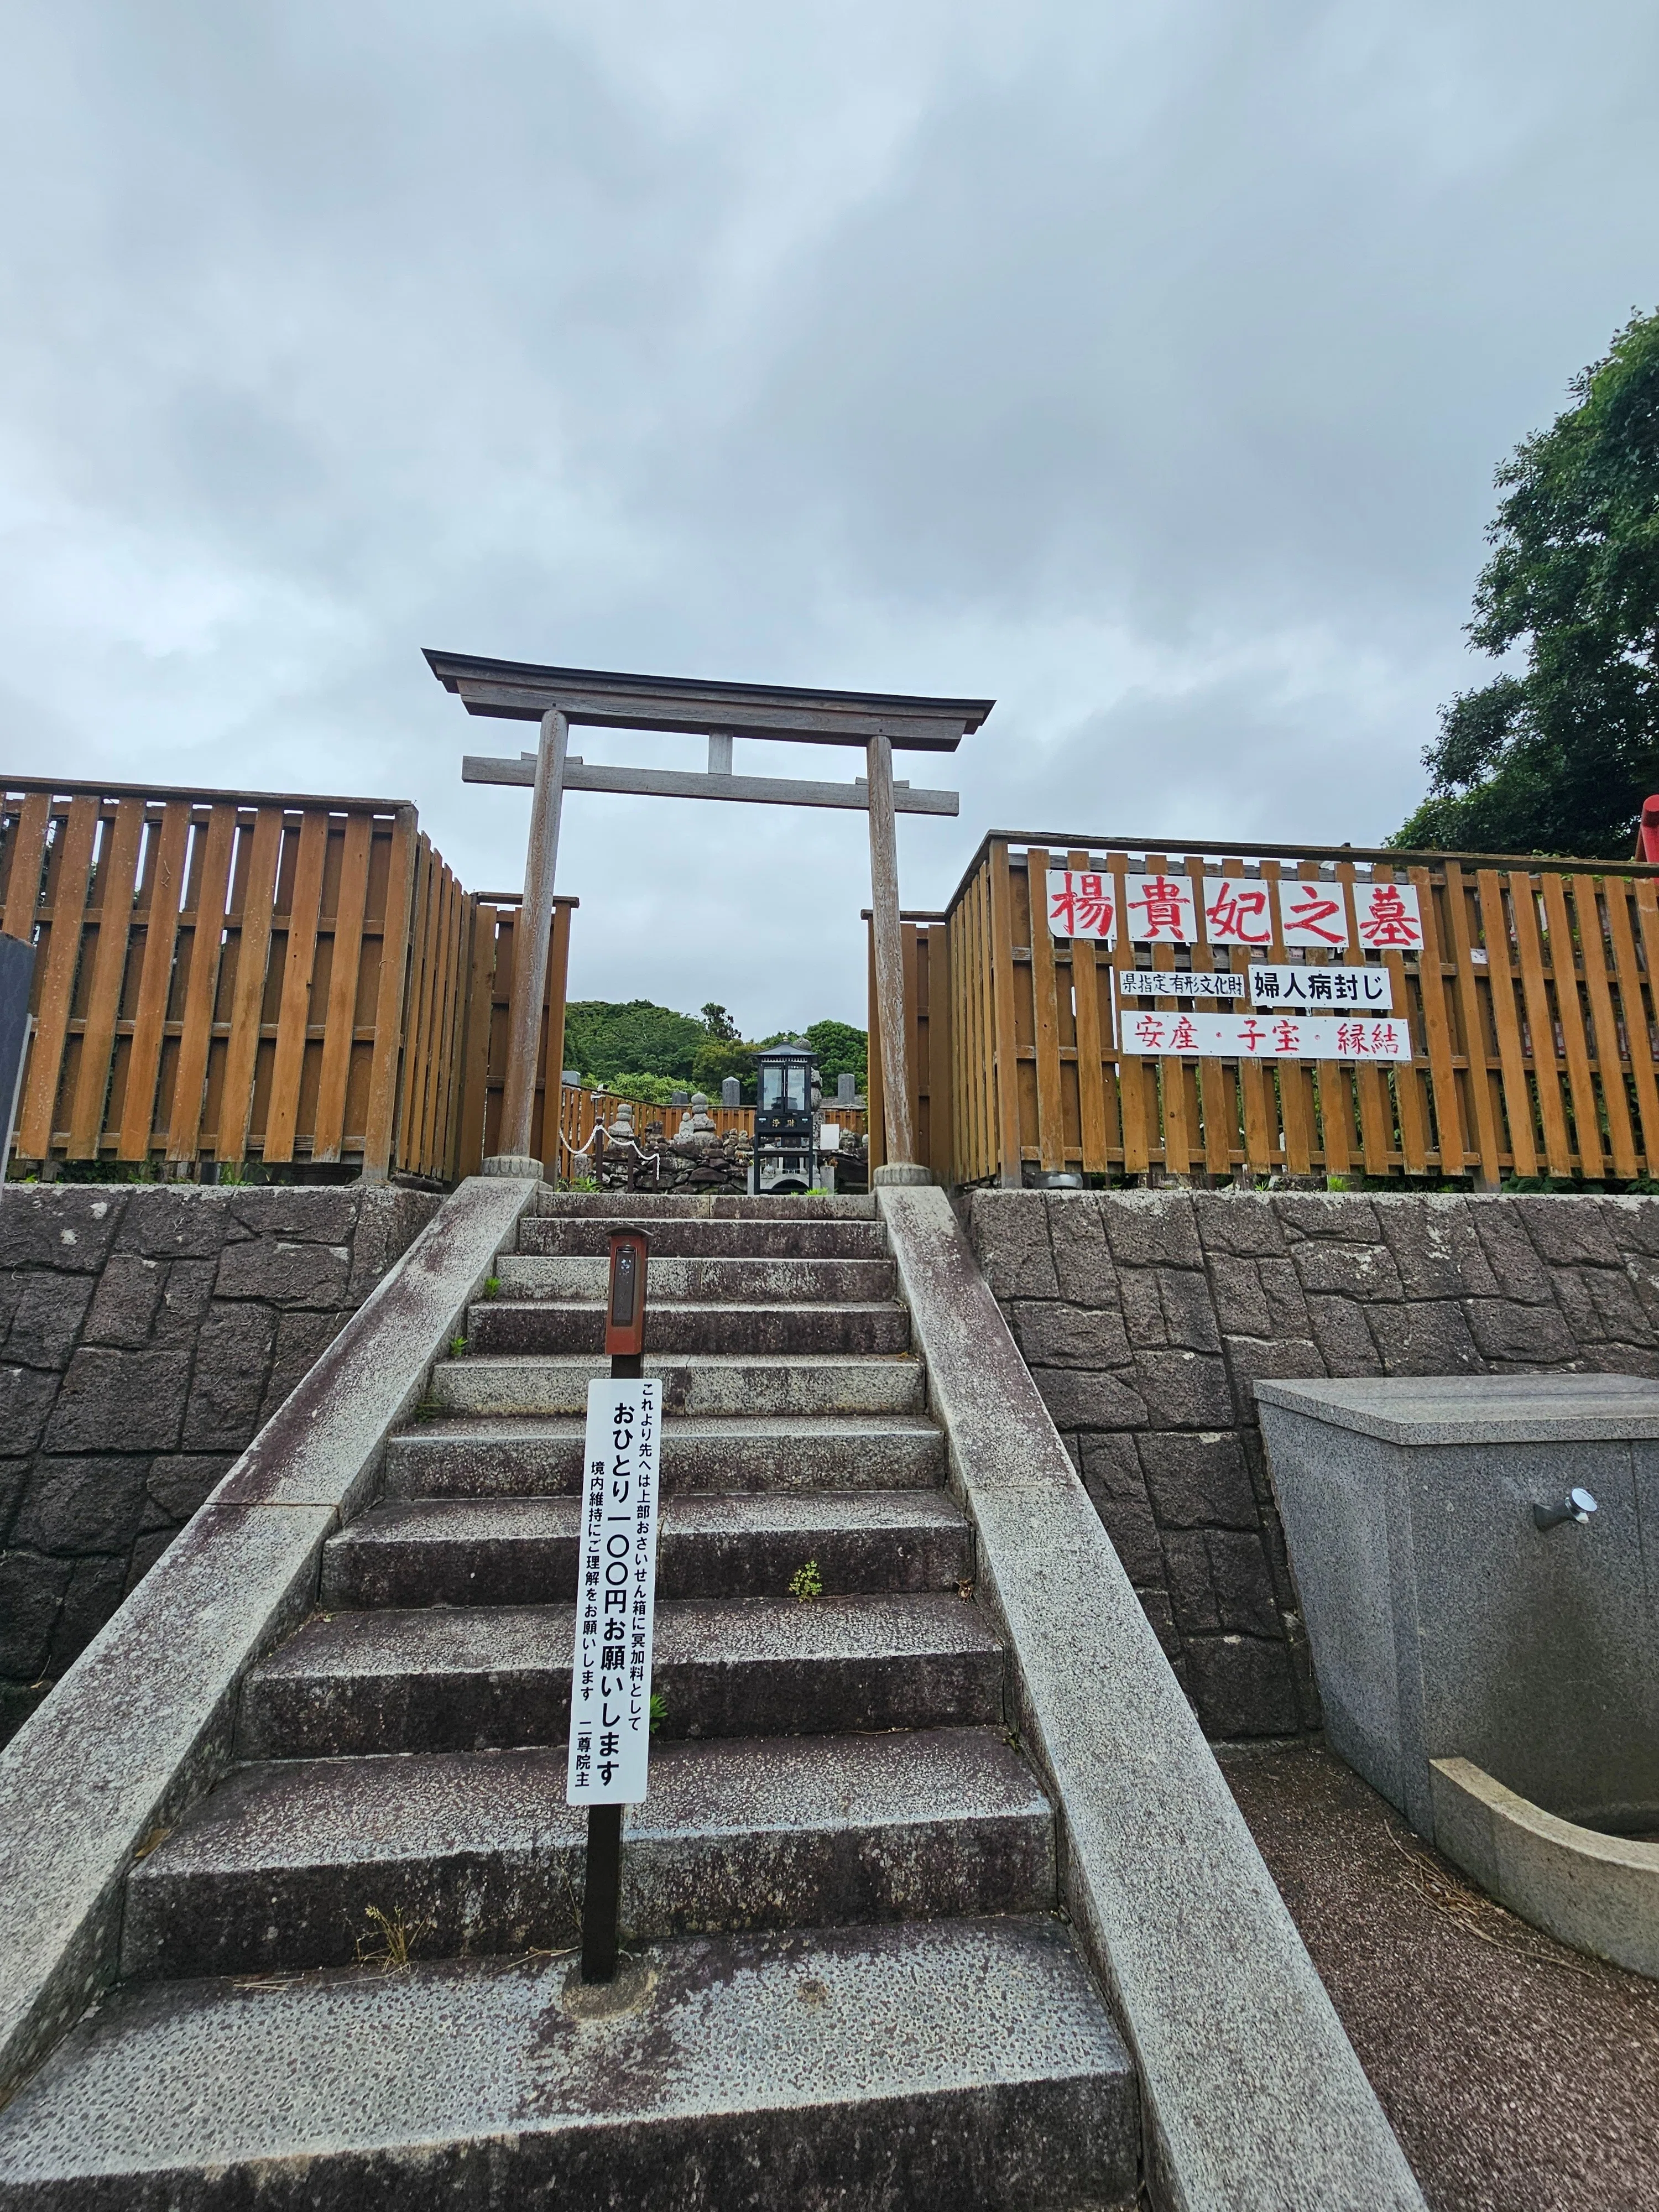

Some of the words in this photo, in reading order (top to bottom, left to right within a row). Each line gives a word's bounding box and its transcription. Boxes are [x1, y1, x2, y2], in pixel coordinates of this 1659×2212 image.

[1050, 871, 1420, 947] 楊貴妃之墓
[1123, 973, 1243, 995] 県指定有形文化財
[1255, 972, 1384, 1000] 婦人病封じ
[581, 1460, 605, 1702] 境内維持にご理解をお願いします
[628, 1384, 654, 1731] これより先へは上部おさいせん箱に冥加料として
[575, 1721, 592, 1787] 二尊院主
